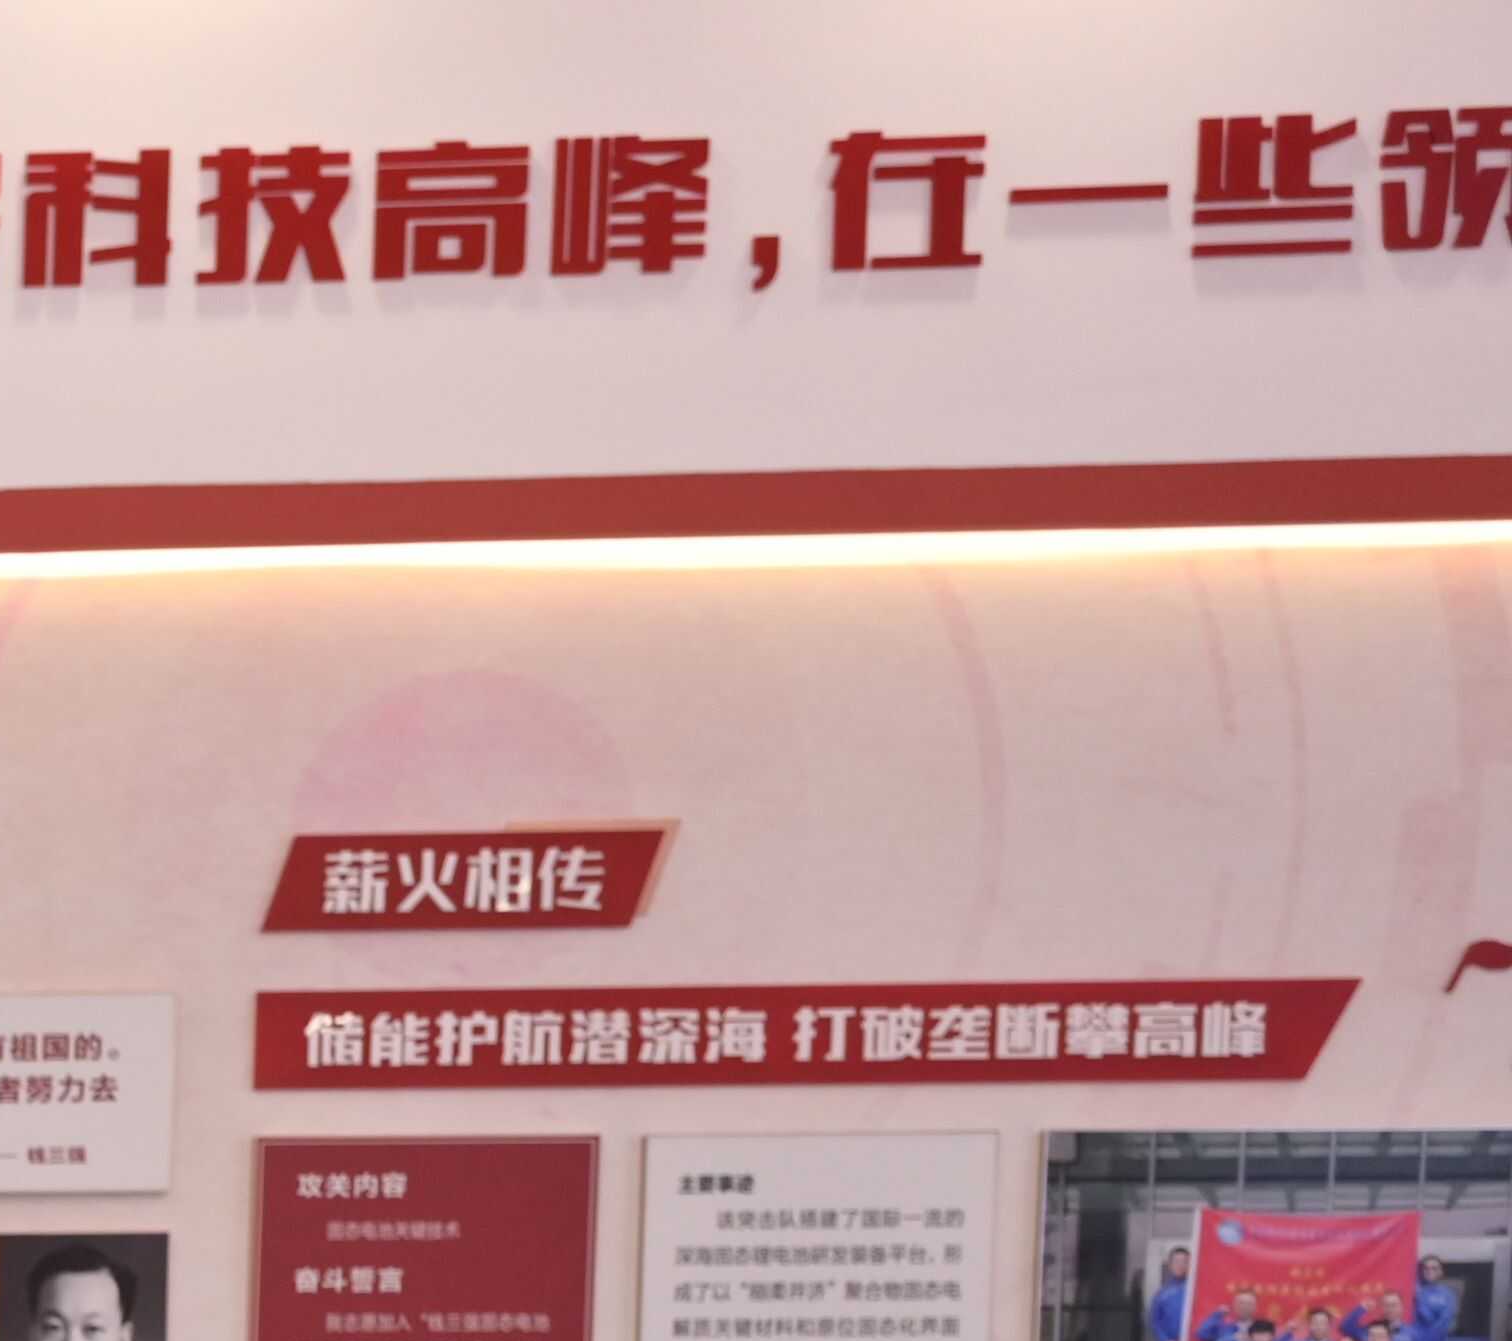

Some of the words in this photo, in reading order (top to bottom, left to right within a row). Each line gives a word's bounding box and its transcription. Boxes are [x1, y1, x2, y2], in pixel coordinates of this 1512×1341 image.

[321, 846, 606, 914] 薪火相传
[304, 1009, 767, 1070] 储能护航潜深海
[792, 1000, 1267, 1063] 打破垄断攀高峰
[294, 1267, 404, 1293] 奋斗誓言
